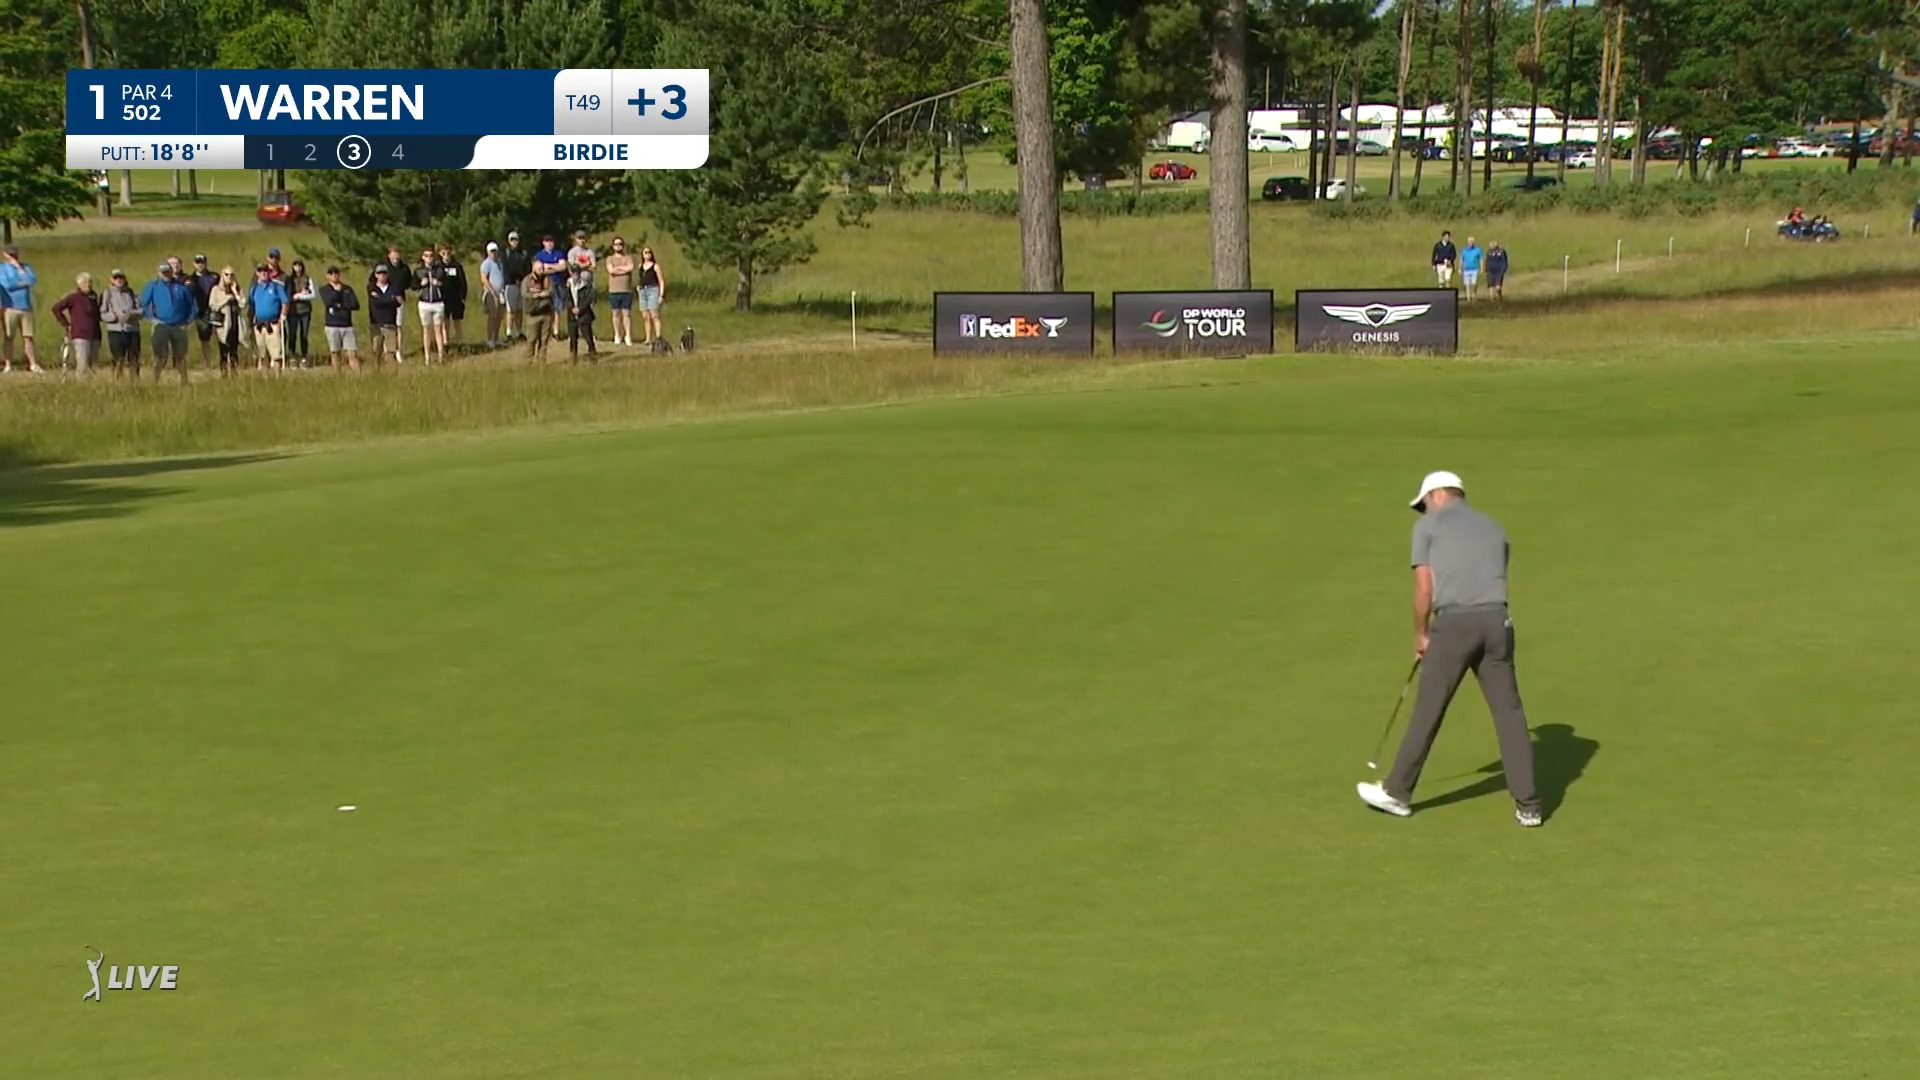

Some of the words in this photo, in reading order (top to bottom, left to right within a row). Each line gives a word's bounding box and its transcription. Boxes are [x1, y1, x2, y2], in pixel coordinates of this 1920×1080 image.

[1183, 309, 1200, 318] DP
[1201, 308, 1245, 318] WORLD
[979, 317, 1040, 338] FedEx
[1184, 319, 1246, 340] TOUR
[1352, 332, 1400, 342] GENESIS
